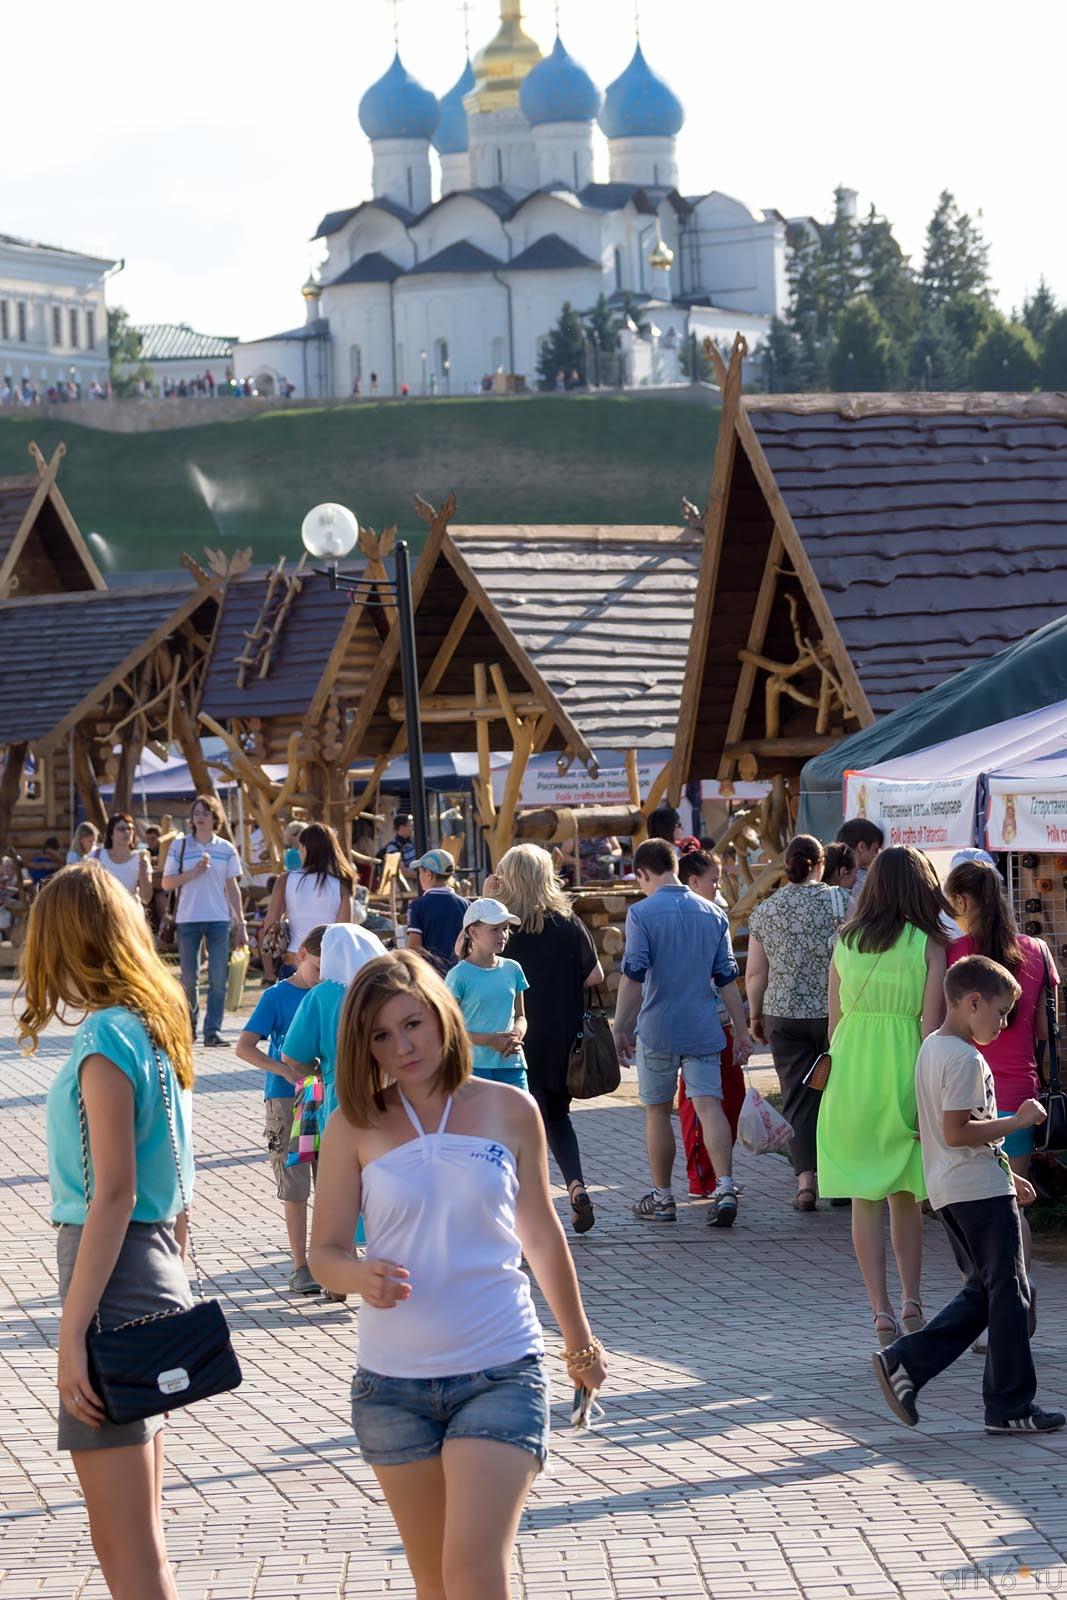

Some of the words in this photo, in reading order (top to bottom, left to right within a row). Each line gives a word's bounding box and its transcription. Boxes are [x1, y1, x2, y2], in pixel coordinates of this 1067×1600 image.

[574, 791, 595, 800] crafts
[890, 827, 901, 844] Folk
[902, 826, 917, 843] crafts
[917, 826, 923, 843] of
[1046, 824, 1060, 844] Folk
